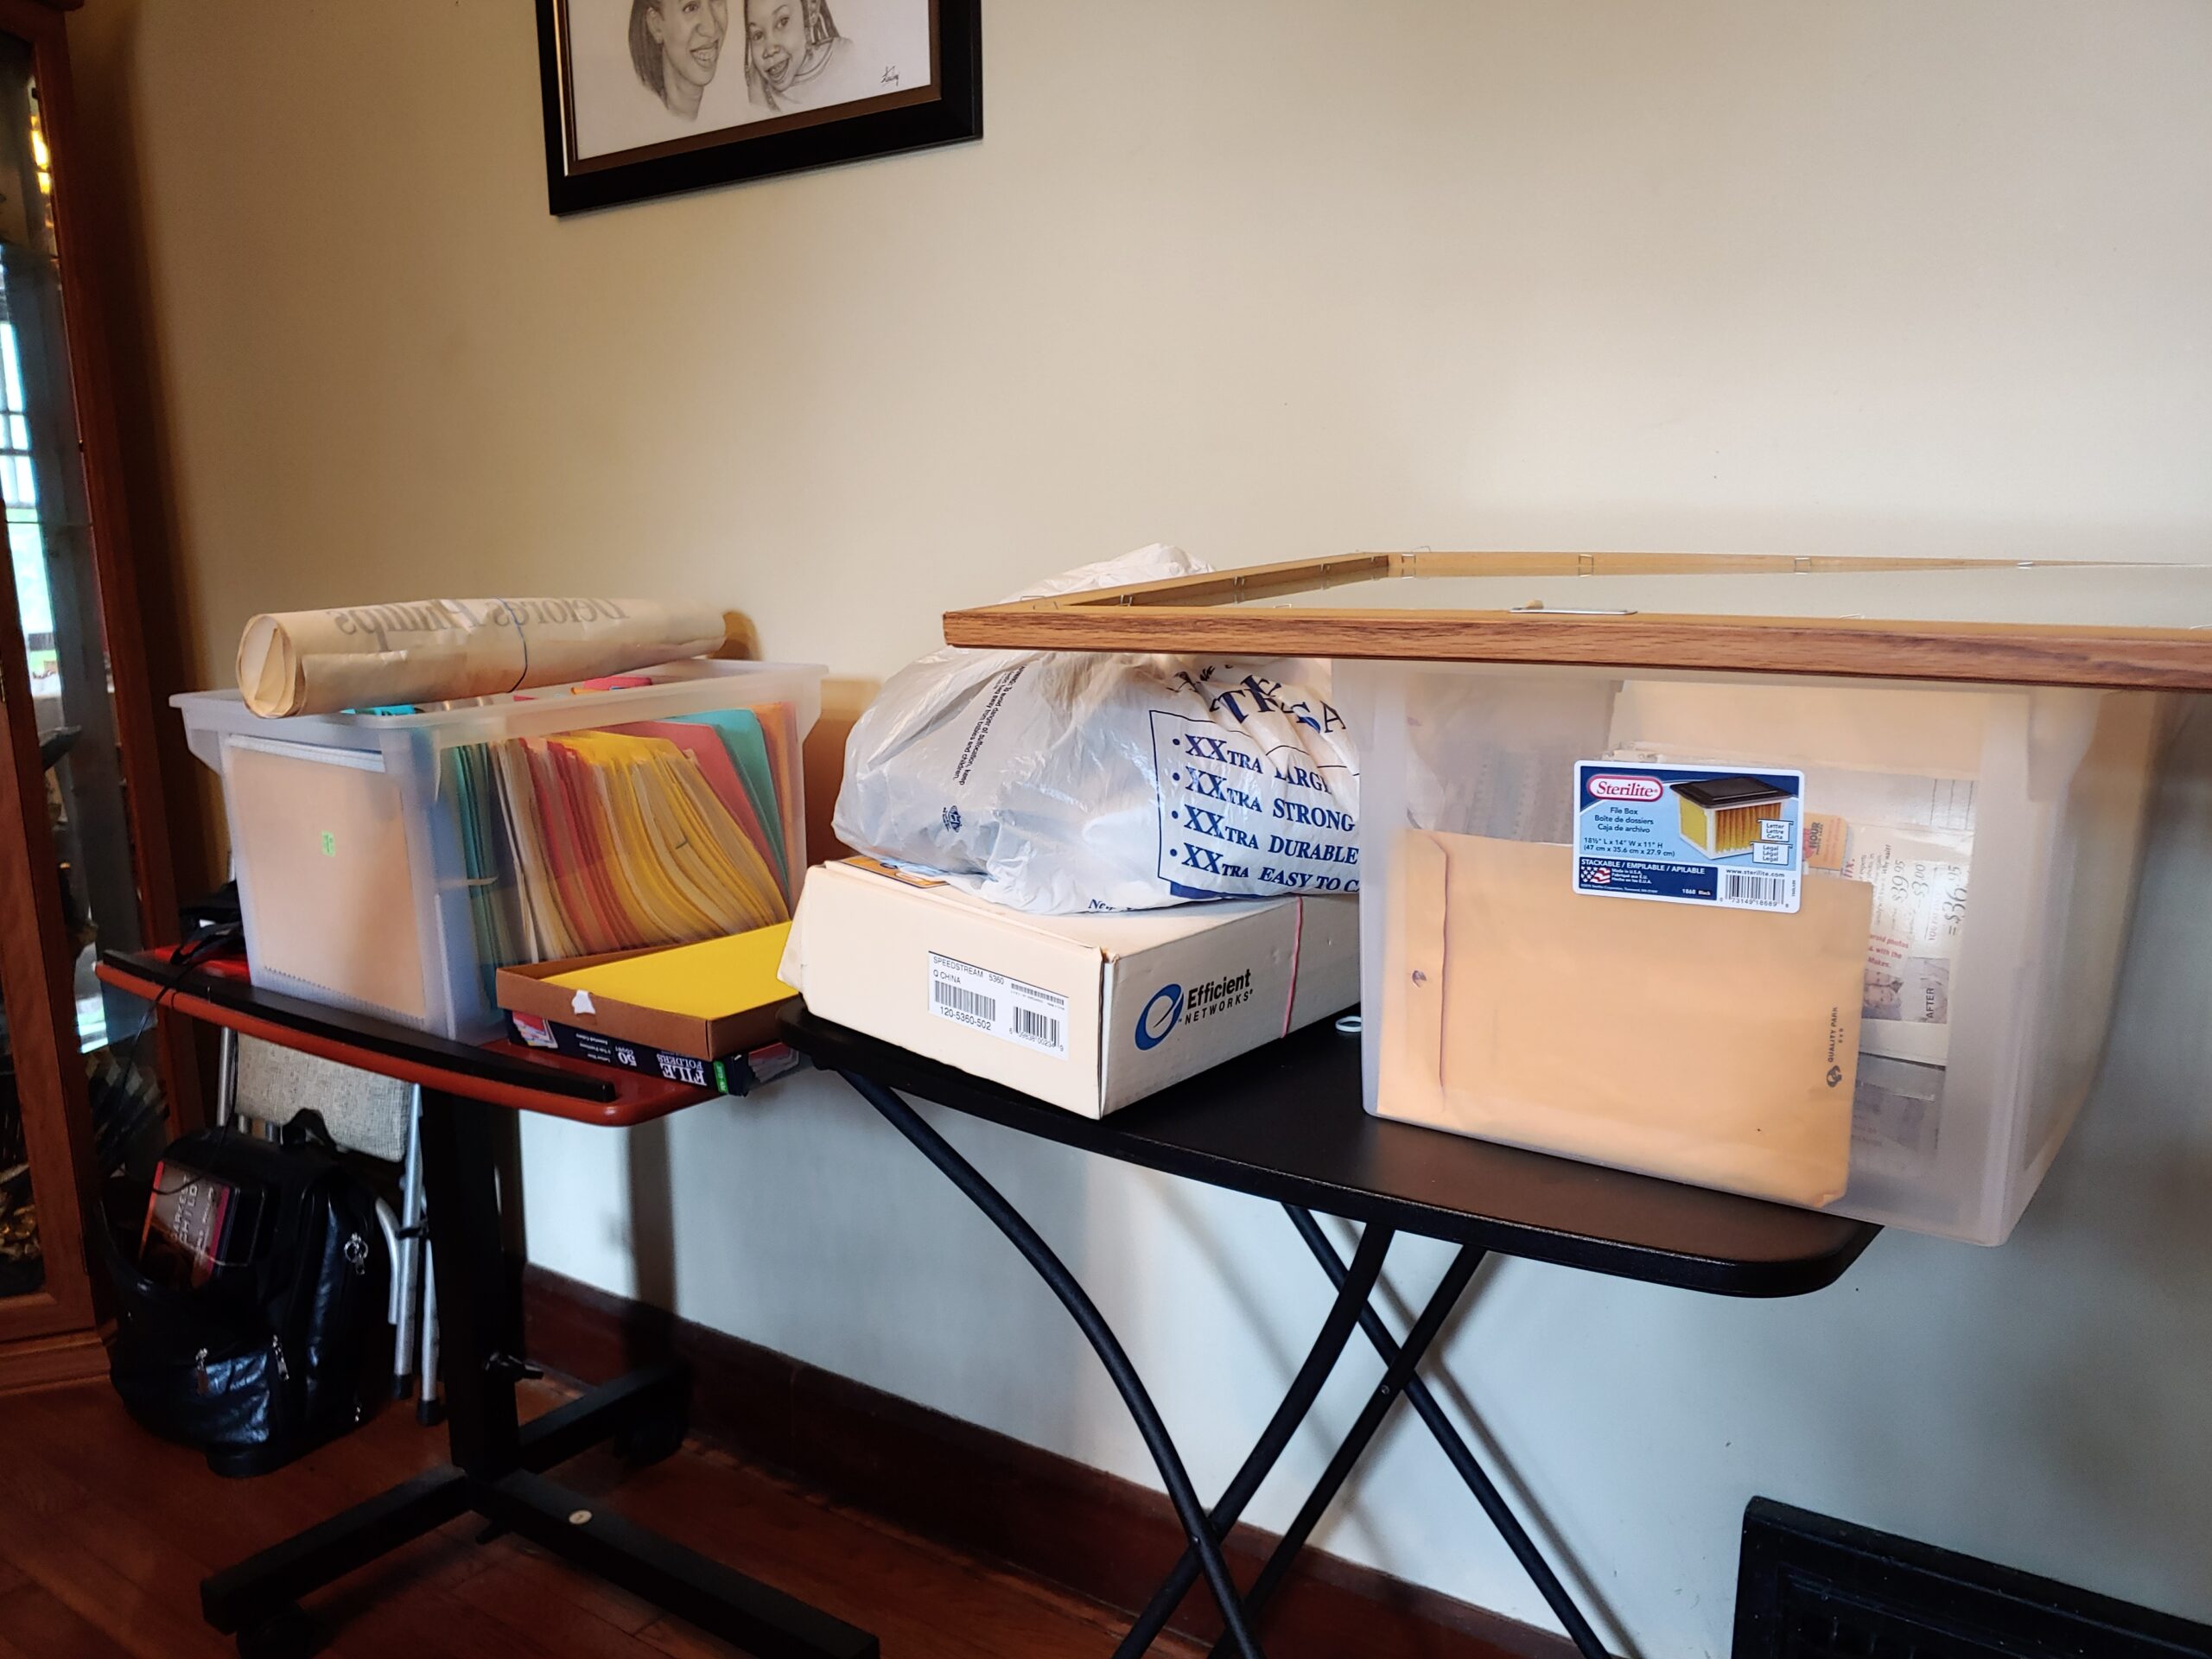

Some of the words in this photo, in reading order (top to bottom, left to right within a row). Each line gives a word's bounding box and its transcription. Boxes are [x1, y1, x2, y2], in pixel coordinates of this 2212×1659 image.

[986, 695, 999, 708] away
[985, 707, 999, 727] danger
[970, 721, 983, 741] babies
[964, 741, 973, 753] and
[1185, 734, 1263, 774] XXTRA
[959, 769, 971, 785] keep
[1185, 766, 1262, 812] XXTRA
[1273, 798, 1355, 832] STRONG
[1597, 781, 1654, 797] Sterilite
[1598, 823, 1612, 832] Caja
[1625, 817, 1654, 825] dossiers
[1184, 804, 1259, 849] XXTRA
[1268, 835, 1359, 864] DURABLE
[1809, 822, 1819, 849] HOUR
[1181, 842, 1249, 878] XXTRA
[1258, 867, 1313, 888] EASY
[1316, 875, 1341, 891] TO
[1581, 859, 1620, 868] STACKABLE
[1626, 862, 1665, 872] EMPILABLE
[933, 957, 983, 977] SPEEDSTREAM
[988, 974, 1005, 985] 5360
[940, 971, 961, 984] CHINA
[1187, 969, 1251, 1010] Efficient
[1925, 987, 1935, 1019] AFTER
[940, 1006, 991, 1031] 120-5360-502
[1827, 1030, 1836, 1063] QUALITY
[618, 1051, 637, 1067] 50
[657, 1052, 704, 1071] FOLDERS
[659, 1062, 707, 1087] FILE
